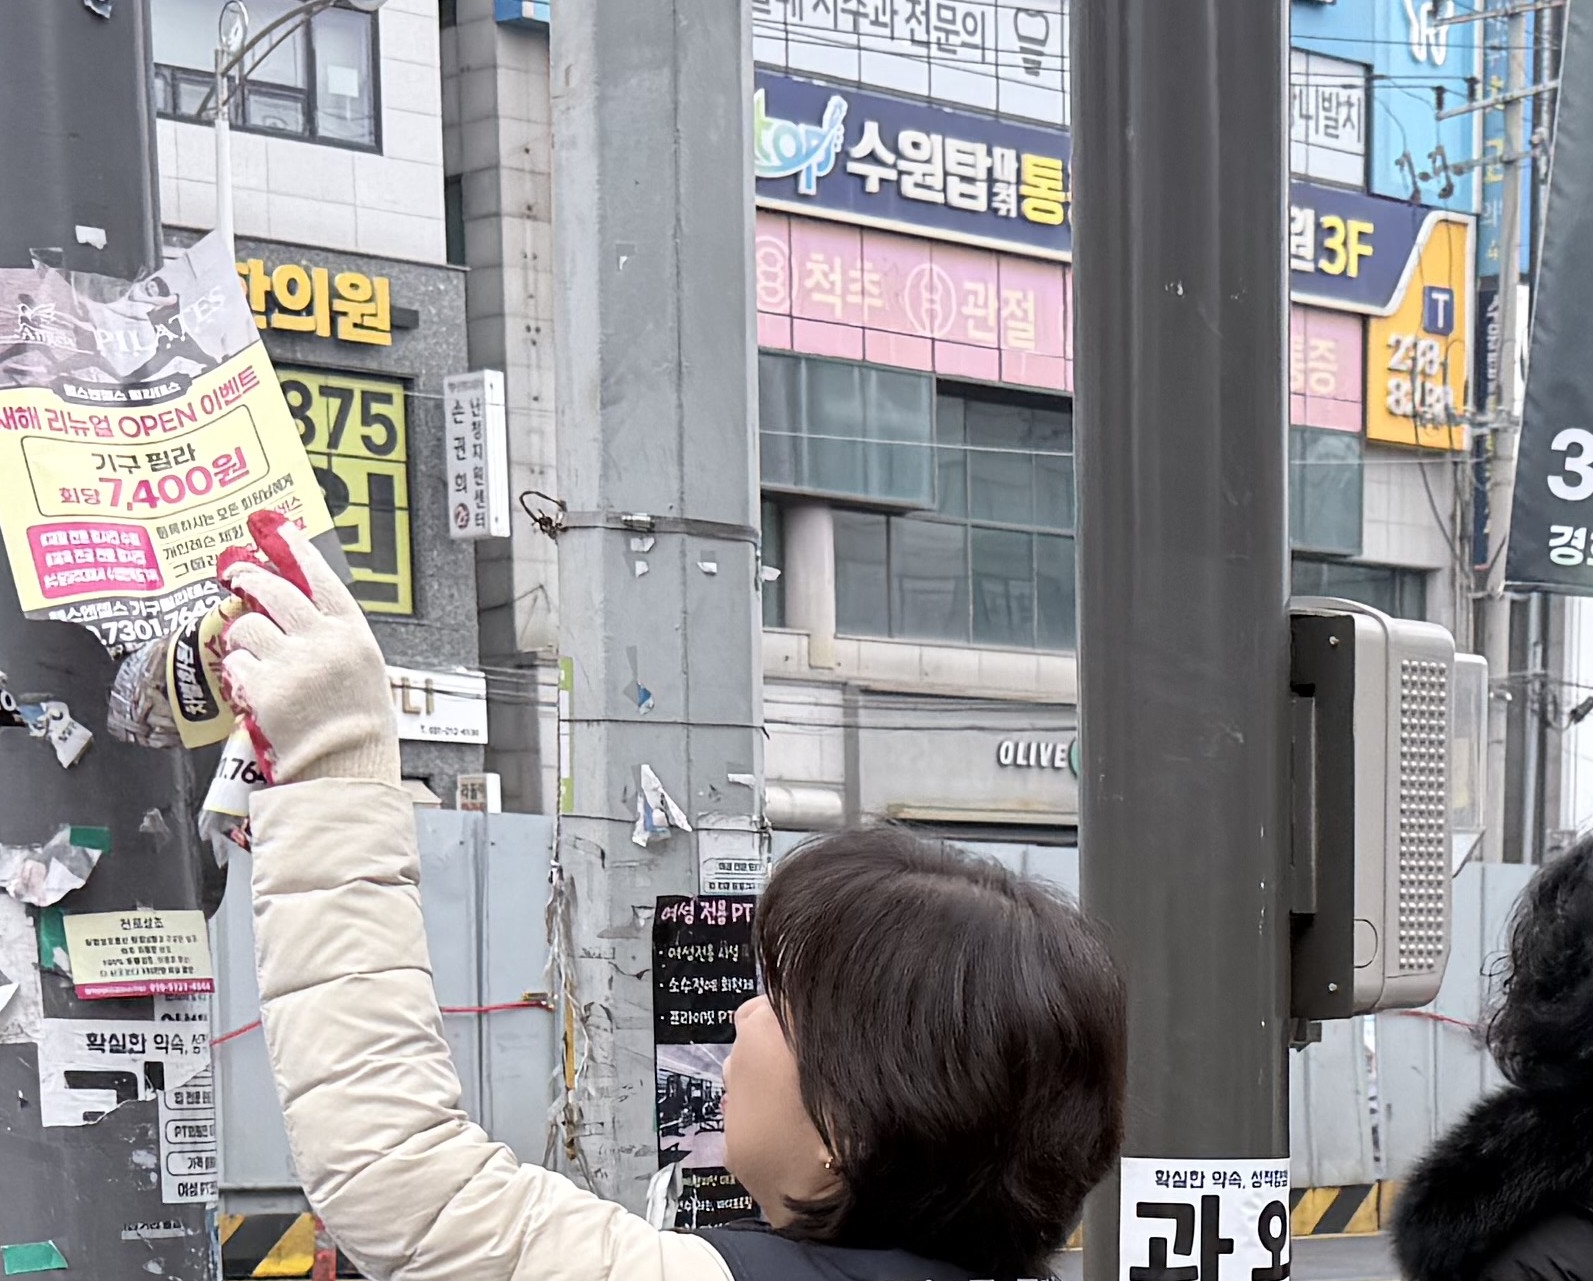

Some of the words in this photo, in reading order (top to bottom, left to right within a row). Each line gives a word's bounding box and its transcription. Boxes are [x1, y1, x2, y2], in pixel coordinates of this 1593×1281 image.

[1292, 86, 1361, 143] 니발치
[1317, 215, 1375, 278] 3F
[44, 407, 115, 438] 리뉴얼
[118, 402, 199, 439] OPEN
[199, 365, 260, 416] 이벤트
[92, 452, 142, 475] 기구
[145, 443, 196, 473] 필라
[98, 446, 250, 511] 7,400원
[999, 739, 1069, 769] OLIVE
[660, 900, 695, 925] 여성
[700, 900, 729, 926] 전용
[731, 903, 754, 922] PT
[670, 1009, 716, 1026] 프라이빗
[85, 1032, 147, 1055] 확실한
[153, 1033, 188, 1056] 약속,
[1155, 1169, 1206, 1189] 확실한
[1212, 1170, 1246, 1190] 약속,
